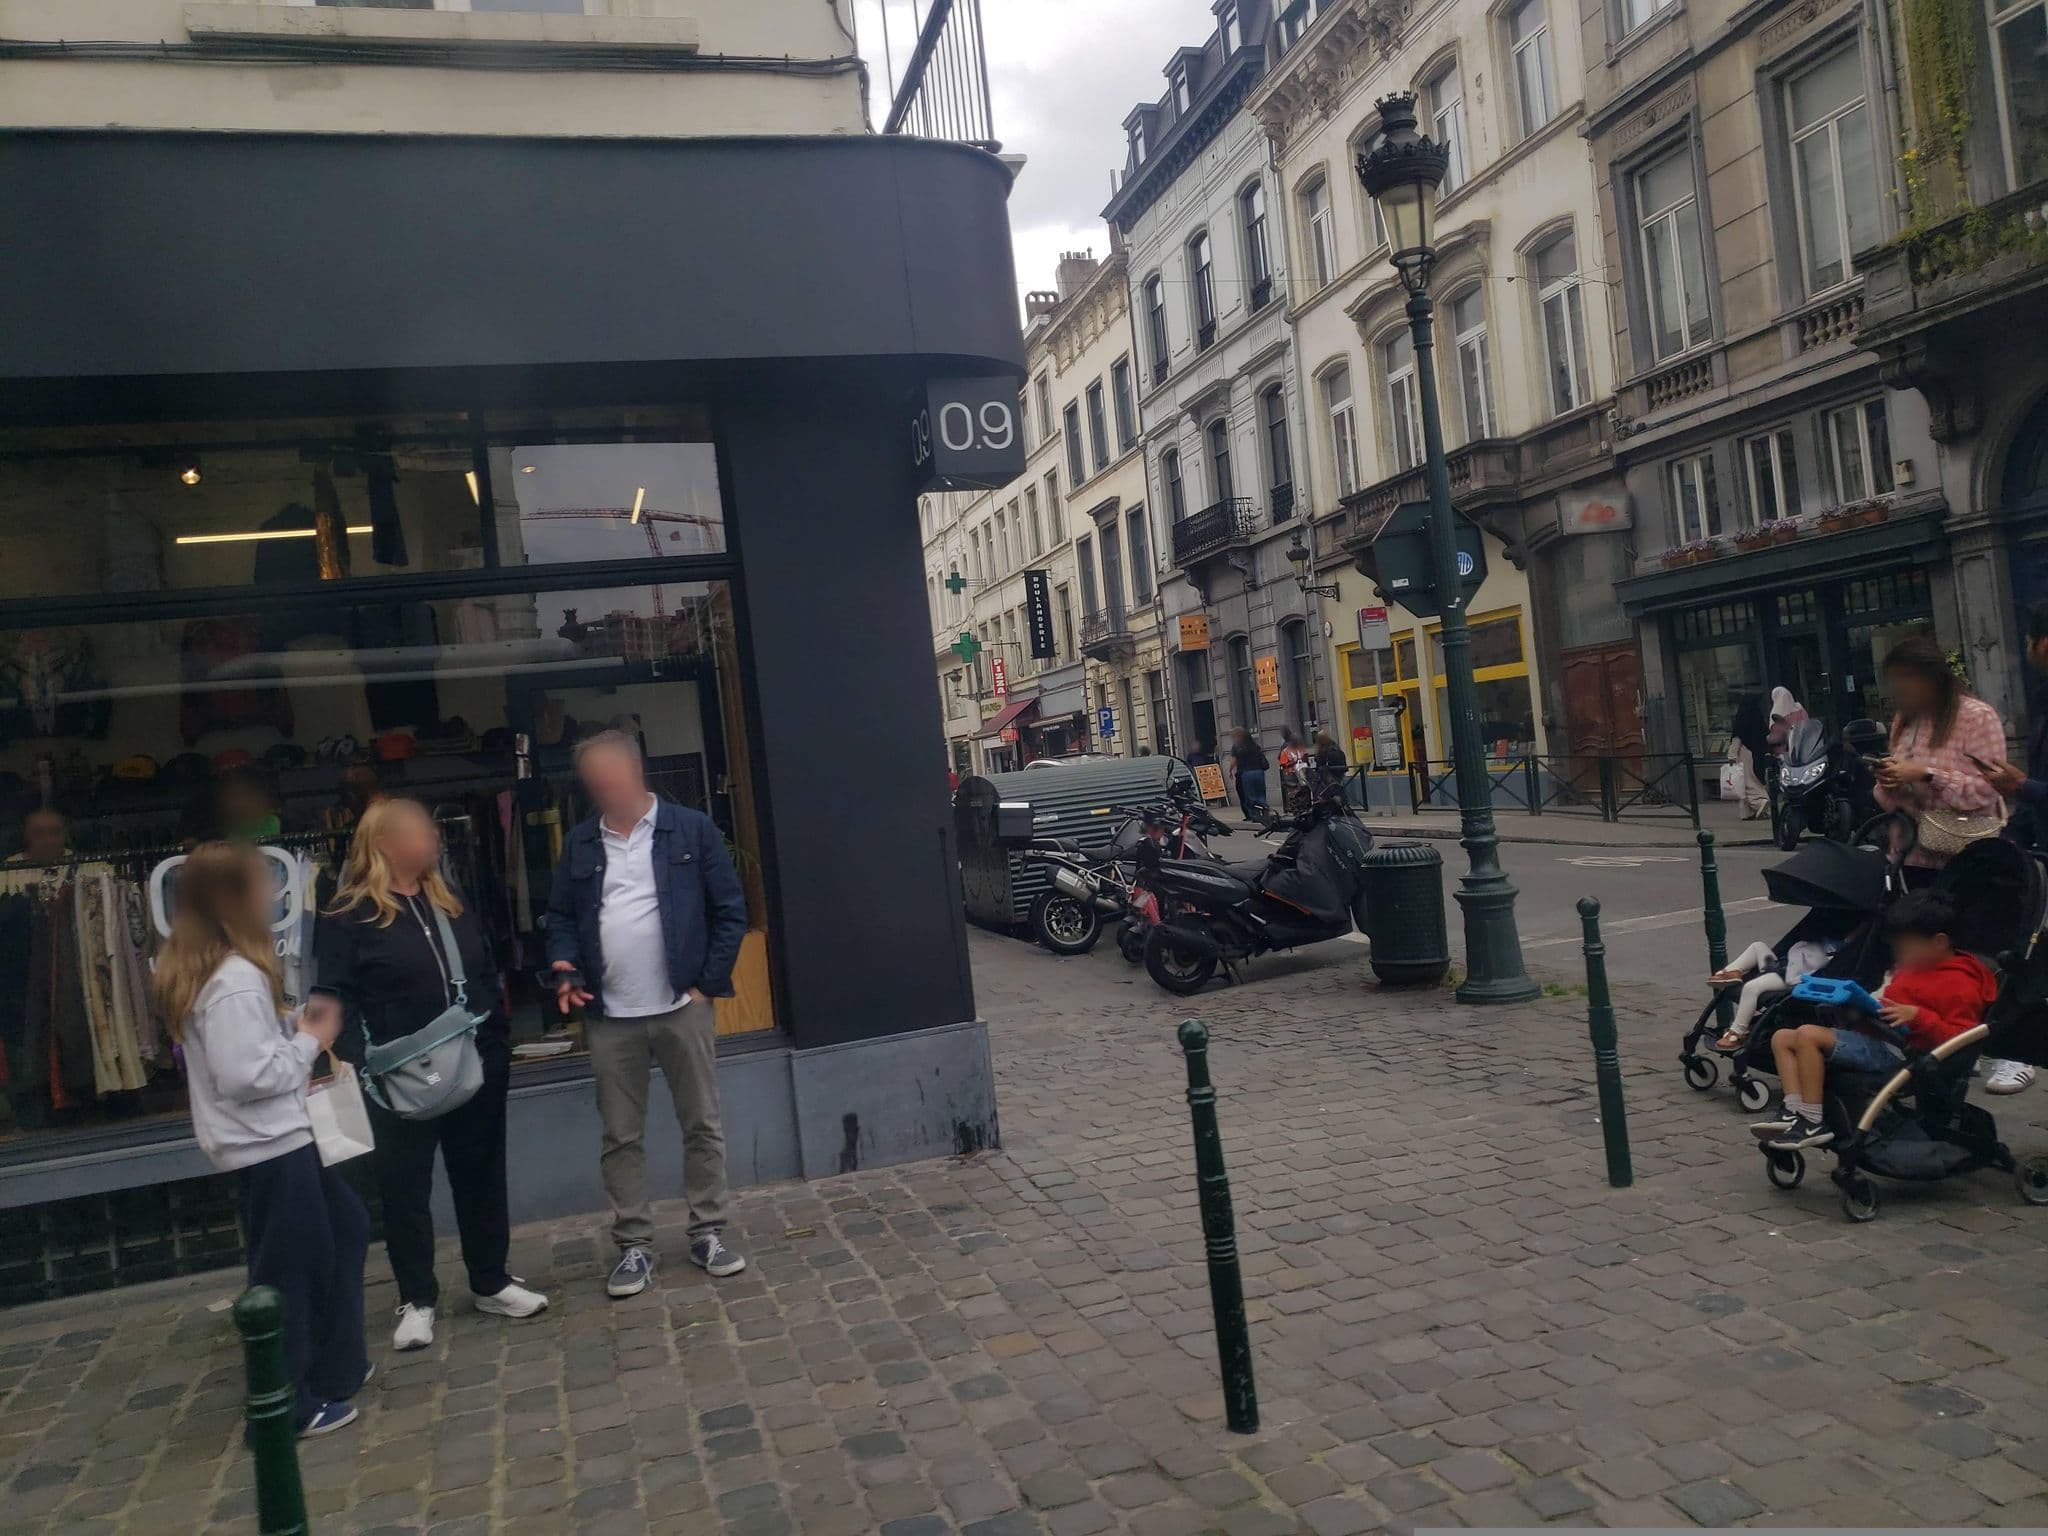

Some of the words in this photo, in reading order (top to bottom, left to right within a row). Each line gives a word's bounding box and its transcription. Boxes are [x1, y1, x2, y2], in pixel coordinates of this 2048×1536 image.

[939, 401, 1014, 451] 0.9
[1032, 576, 1047, 649] BOULANGERIE
[993, 658, 1006, 694] PIZZA
[1099, 710, 1111, 727] P
